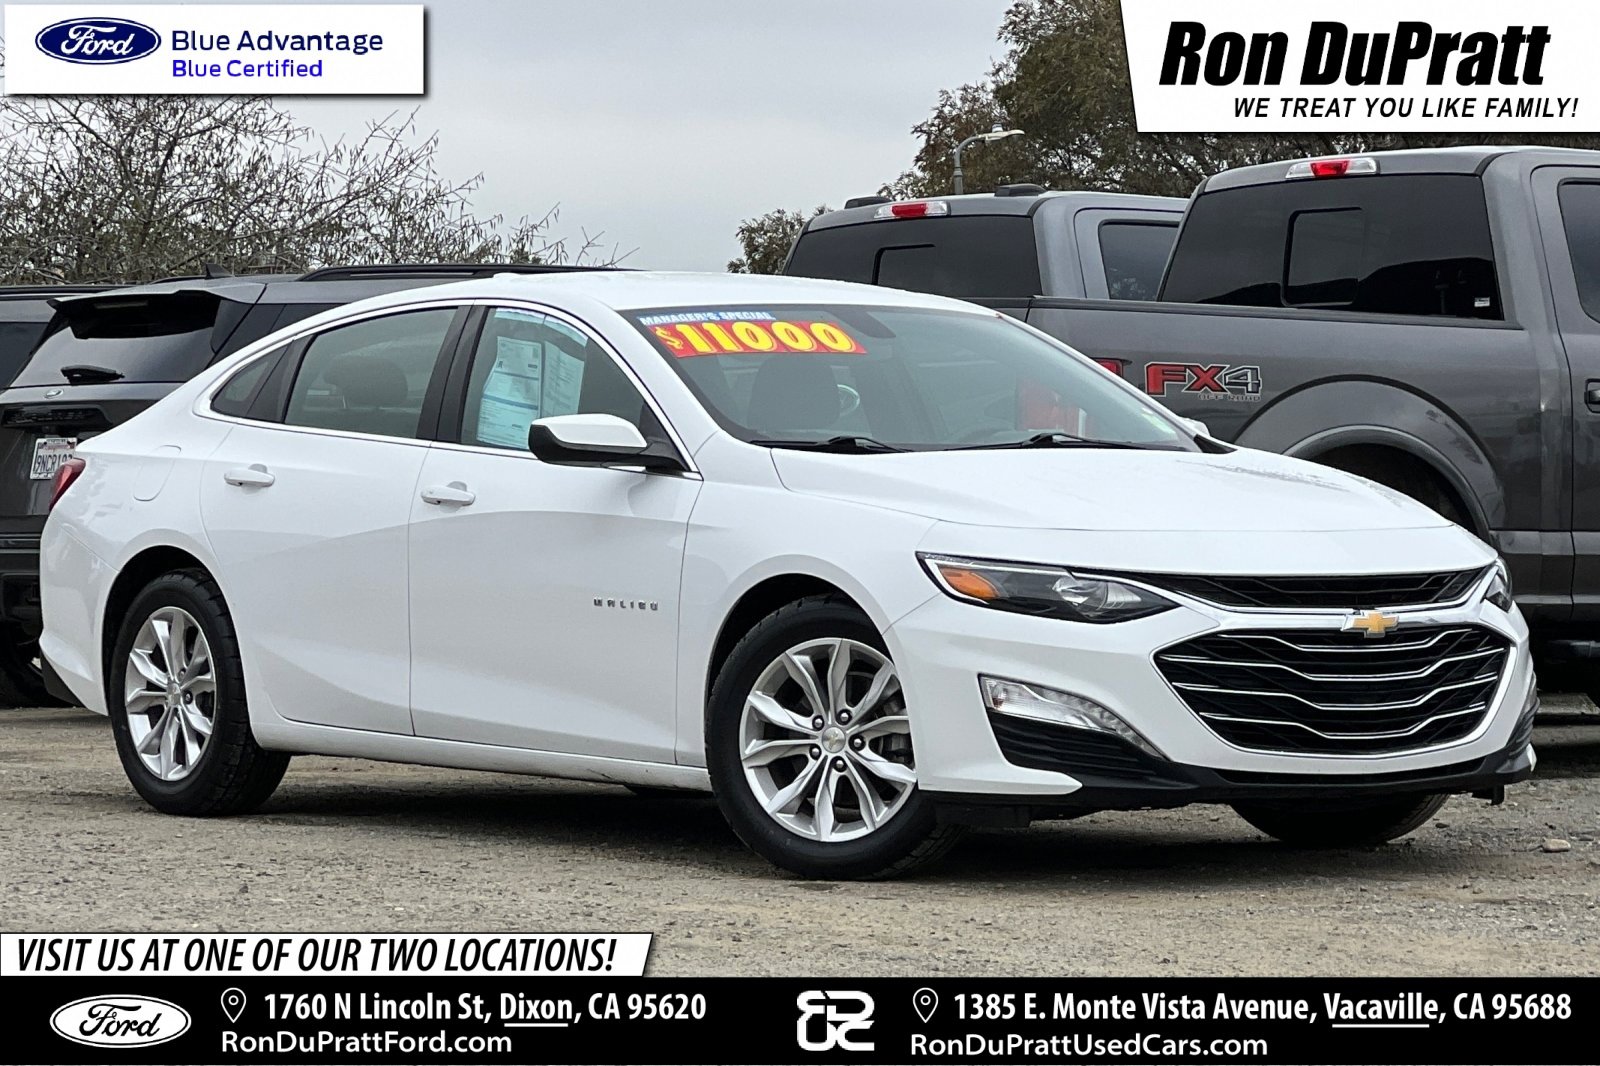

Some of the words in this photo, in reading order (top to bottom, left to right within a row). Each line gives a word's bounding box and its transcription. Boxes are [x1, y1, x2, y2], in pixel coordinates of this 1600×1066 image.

[640, 312, 720, 325] MANAGER'S
[720, 311, 776, 321] SPECIAL
[655, 320, 858, 354] $11000
[1144, 361, 1263, 398] FX4
[593, 597, 659, 611] MALIBU
